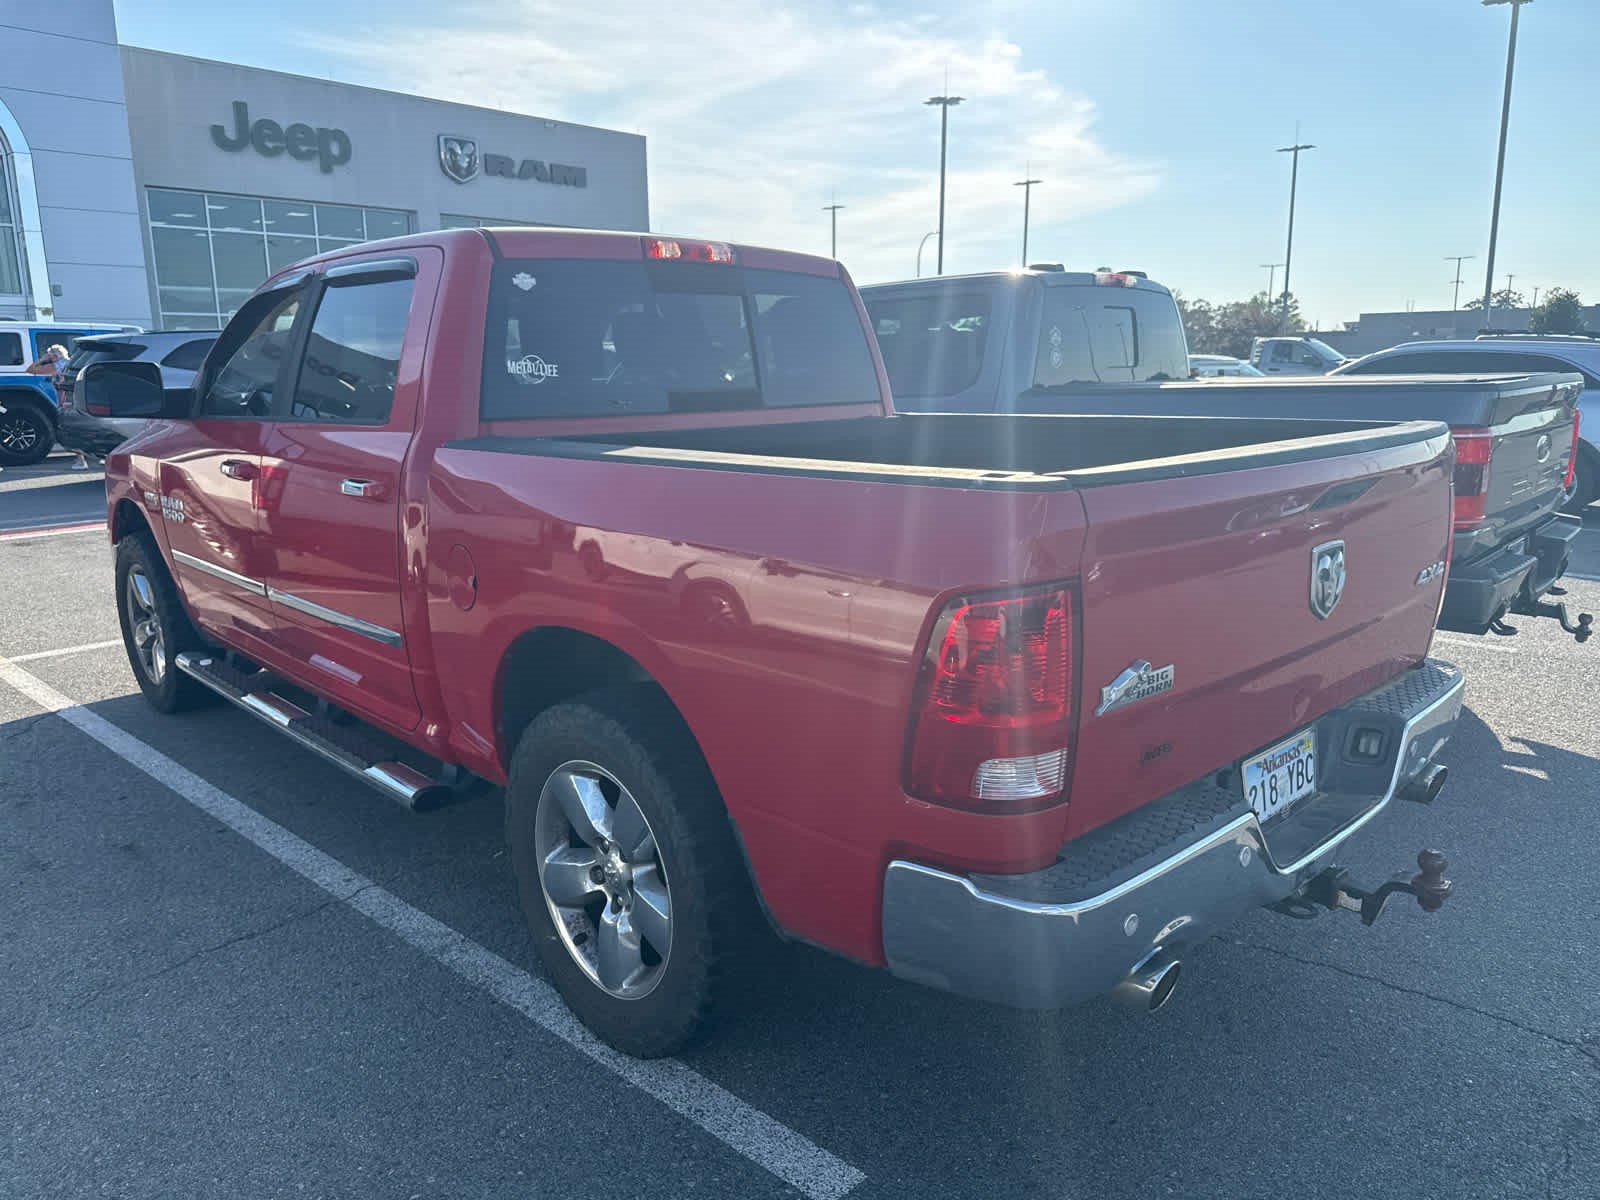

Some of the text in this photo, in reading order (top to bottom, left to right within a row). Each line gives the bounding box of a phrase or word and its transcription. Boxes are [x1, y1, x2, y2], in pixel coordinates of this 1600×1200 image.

[210, 100, 352, 174] Jeep
[484, 153, 587, 188] RAM
[1136, 679, 1172, 699] HORN
[1147, 670, 1169, 686] BIG
[1261, 744, 1301, 778] Arkansas
[1249, 753, 1314, 816] 218 YBC
